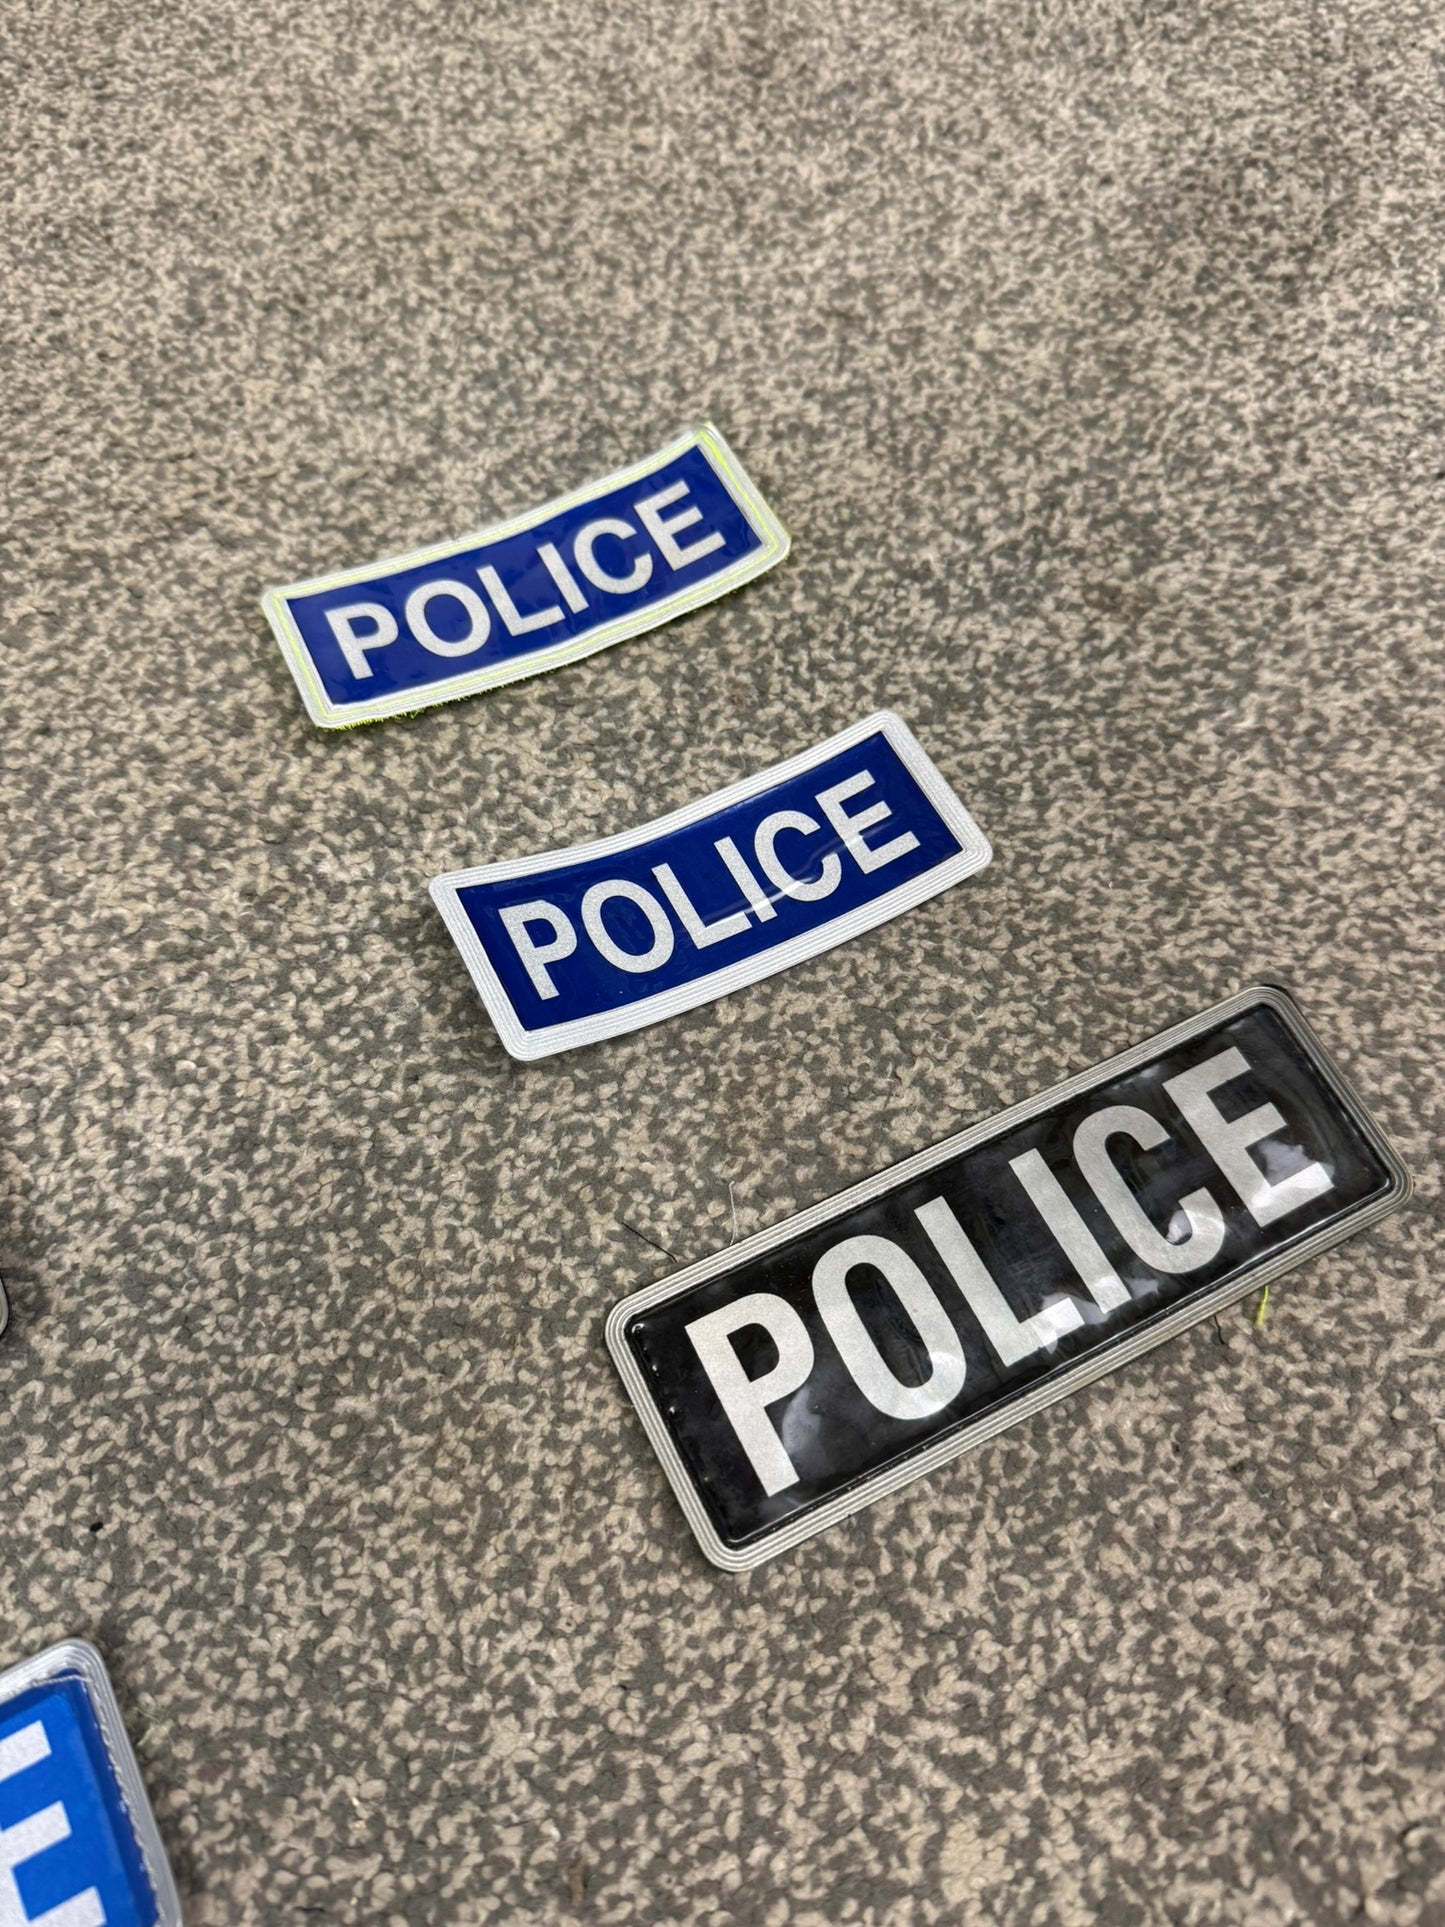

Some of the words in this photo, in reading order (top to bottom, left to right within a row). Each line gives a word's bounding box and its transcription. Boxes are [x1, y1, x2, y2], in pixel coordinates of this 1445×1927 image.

[325, 480, 726, 680] POLICE
[498, 769, 921, 1001] POLICE
[684, 1046, 1335, 1497] POLICE
